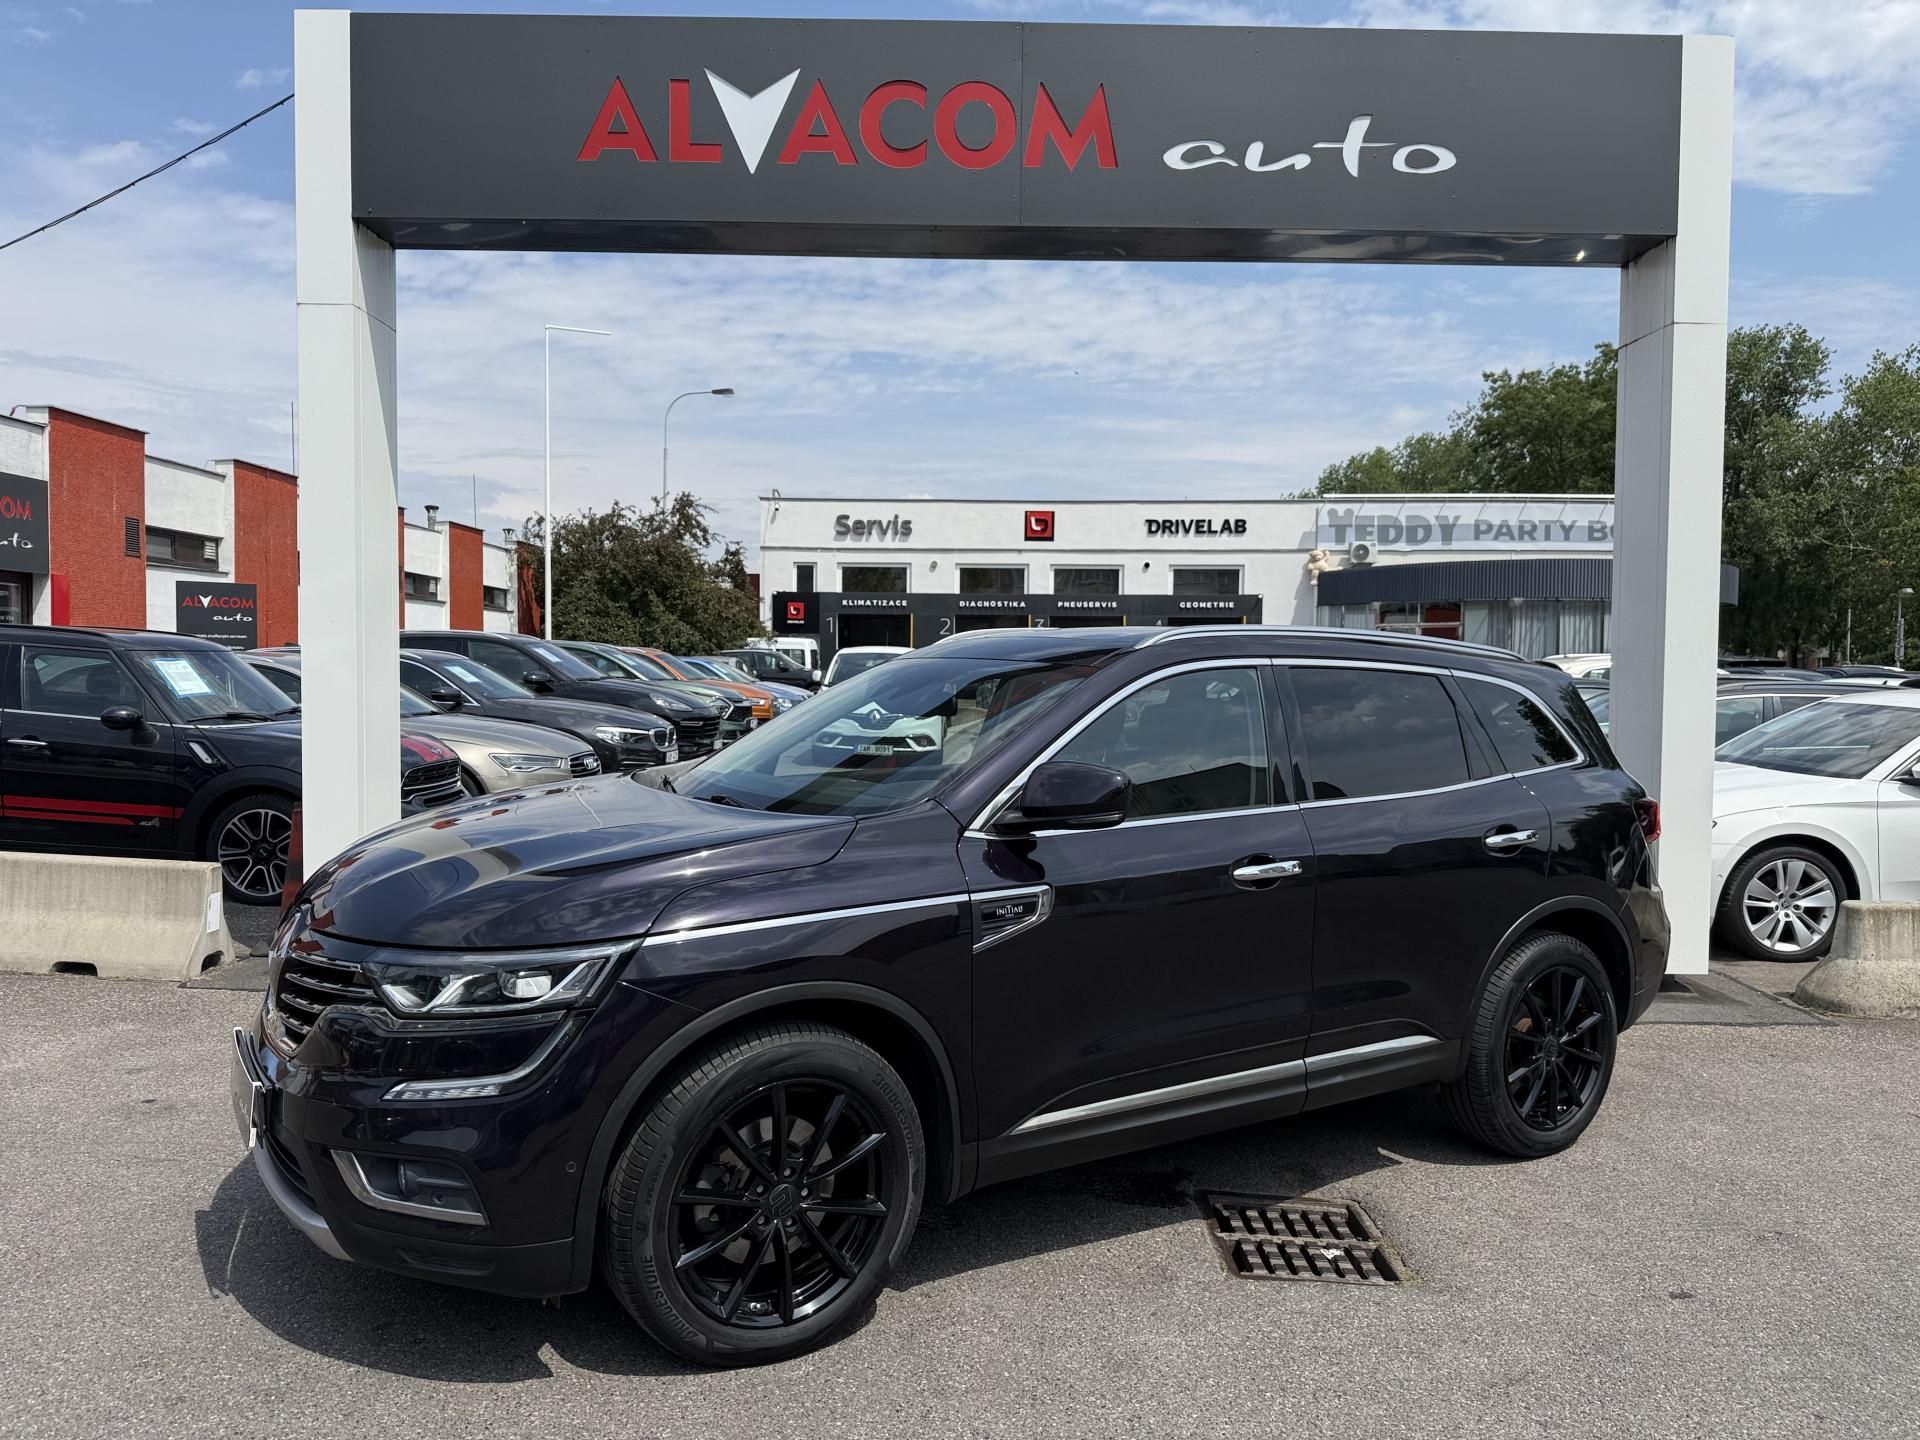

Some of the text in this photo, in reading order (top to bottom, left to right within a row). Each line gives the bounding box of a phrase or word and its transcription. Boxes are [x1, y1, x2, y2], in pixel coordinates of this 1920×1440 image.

[576, 66, 1119, 174] ALVACOM
[1162, 114, 1457, 178] auto
[834, 514, 912, 538] Servis
[1145, 518, 1248, 536] DRIVELAB
[1327, 508, 1615, 546] TEDDY PARTY B
[182, 594, 254, 609] ALVACOM
[842, 599, 908, 607] KLIMATIZACE
[959, 600, 1026, 608] DIAGNOSTIKA
[1057, 600, 1118, 608] PNEUSERVIS
[1179, 601, 1235, 609] GEOMETRIE
[213, 613, 253, 622] auto
[826, 616, 833, 633] 1
[939, 617, 951, 635] 2
[641, 1254, 699, 1343] BRIDGESTONE
